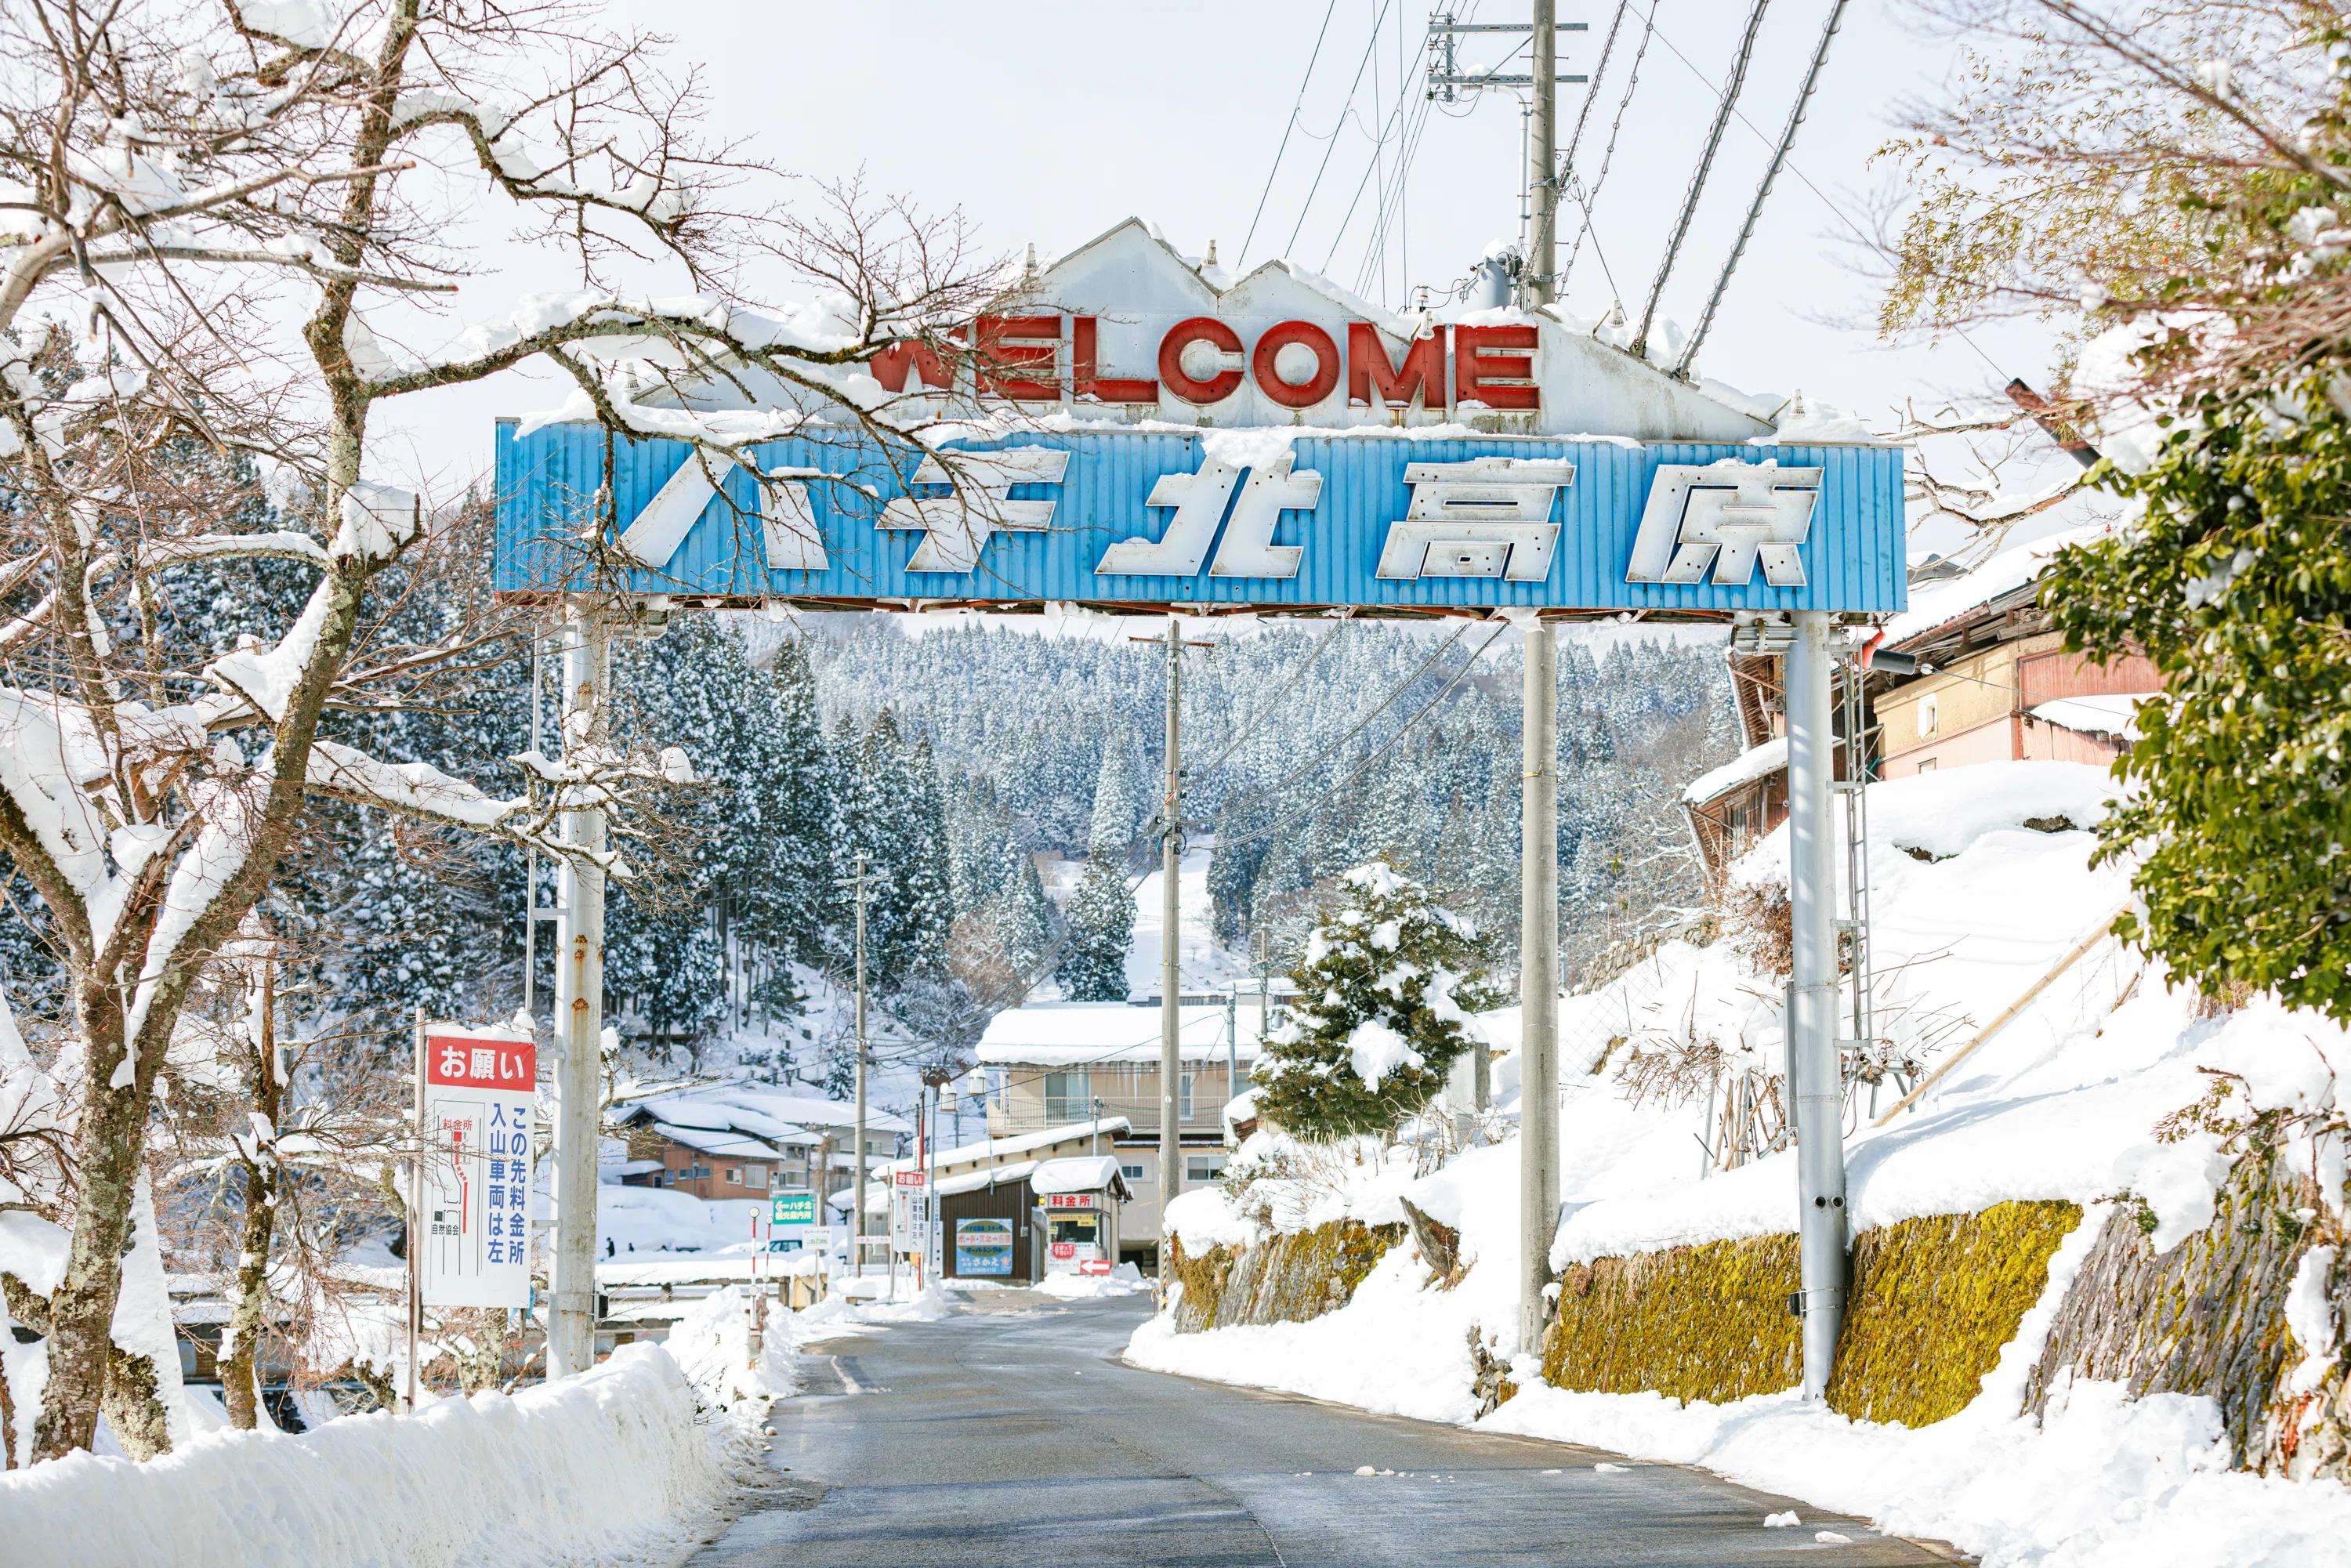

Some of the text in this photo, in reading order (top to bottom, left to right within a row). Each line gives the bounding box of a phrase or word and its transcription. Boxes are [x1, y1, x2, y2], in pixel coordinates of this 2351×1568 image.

[868, 315, 1541, 411] WELCOME
[614, 440, 1826, 588] ハチ北高原
[439, 1045, 525, 1081] お願い
[442, 1118, 473, 1132] 料金所
[487, 1103, 507, 1264] 入山車両は左
[509, 1106, 527, 1266] この先料金所
[898, 1174, 922, 1185] お願い
[789, 1201, 812, 1211] ハチ北
[1052, 1195, 1090, 1207] 料金所
[775, 1211, 812, 1221] 観光案内所
[432, 1224, 459, 1237] 自然協会
[973, 1257, 999, 1267] さかえ
